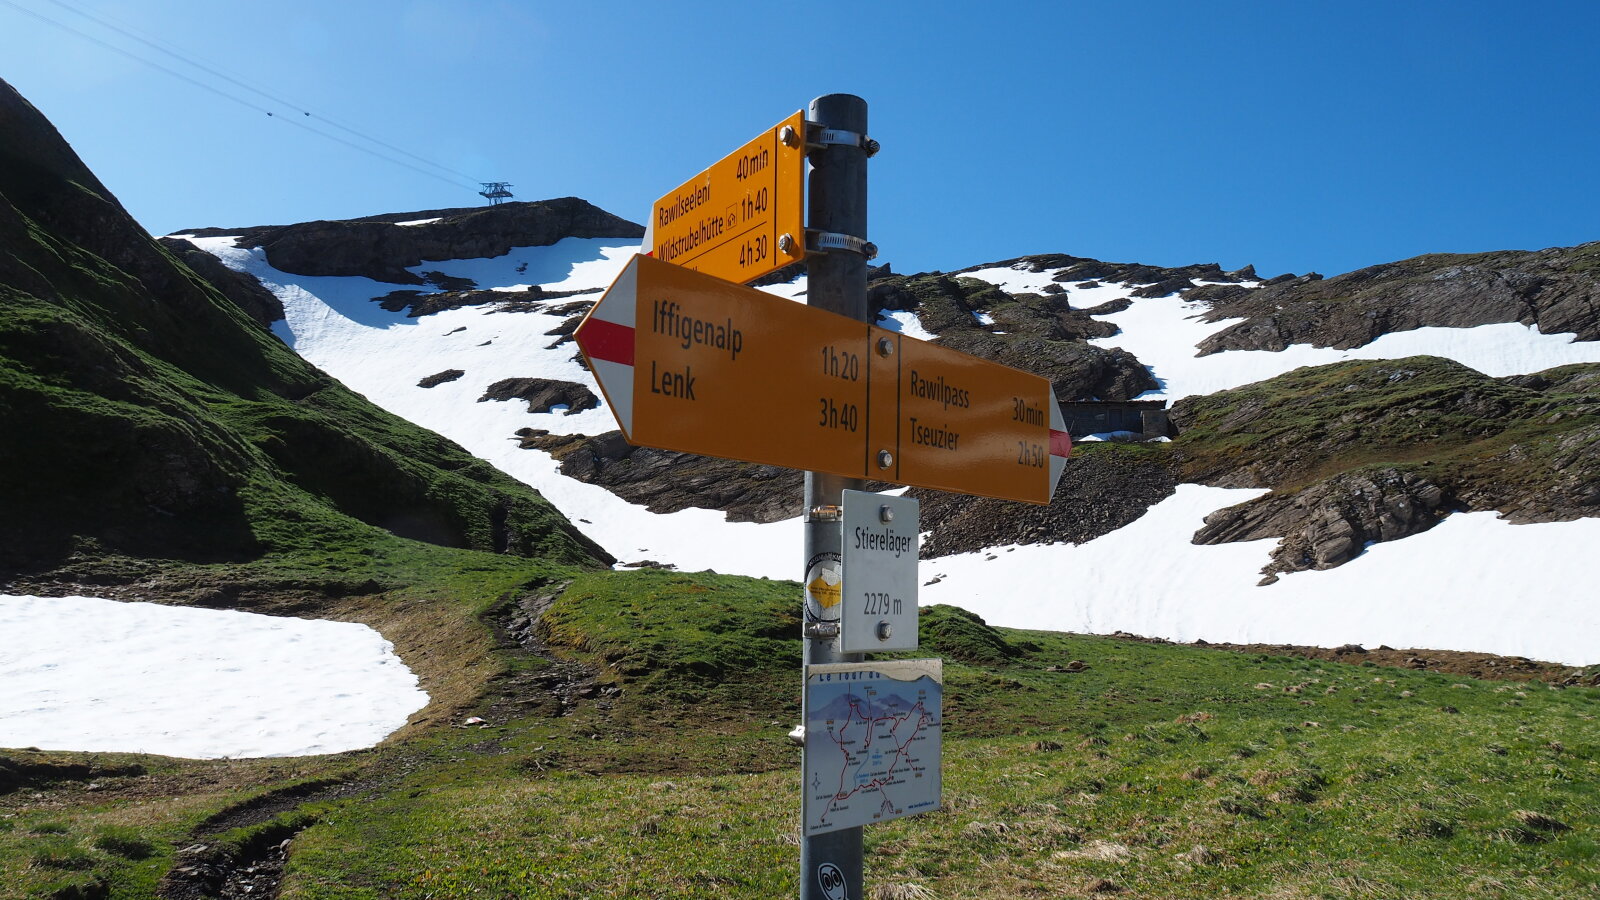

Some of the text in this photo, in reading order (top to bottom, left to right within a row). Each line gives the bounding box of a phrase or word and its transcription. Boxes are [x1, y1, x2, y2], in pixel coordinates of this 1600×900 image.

[659, 183, 711, 229] Rawilseeleni
[658, 216, 724, 262] Wildstrubelhütte
[653, 299, 743, 361] Iffigenalp
[651, 360, 696, 401] Lenk
[910, 369, 970, 411] Rawilpass
[909, 417, 960, 451] Tseuzier
[855, 526, 912, 558] Stiereläger
[863, 592, 902, 615] 2279 m
